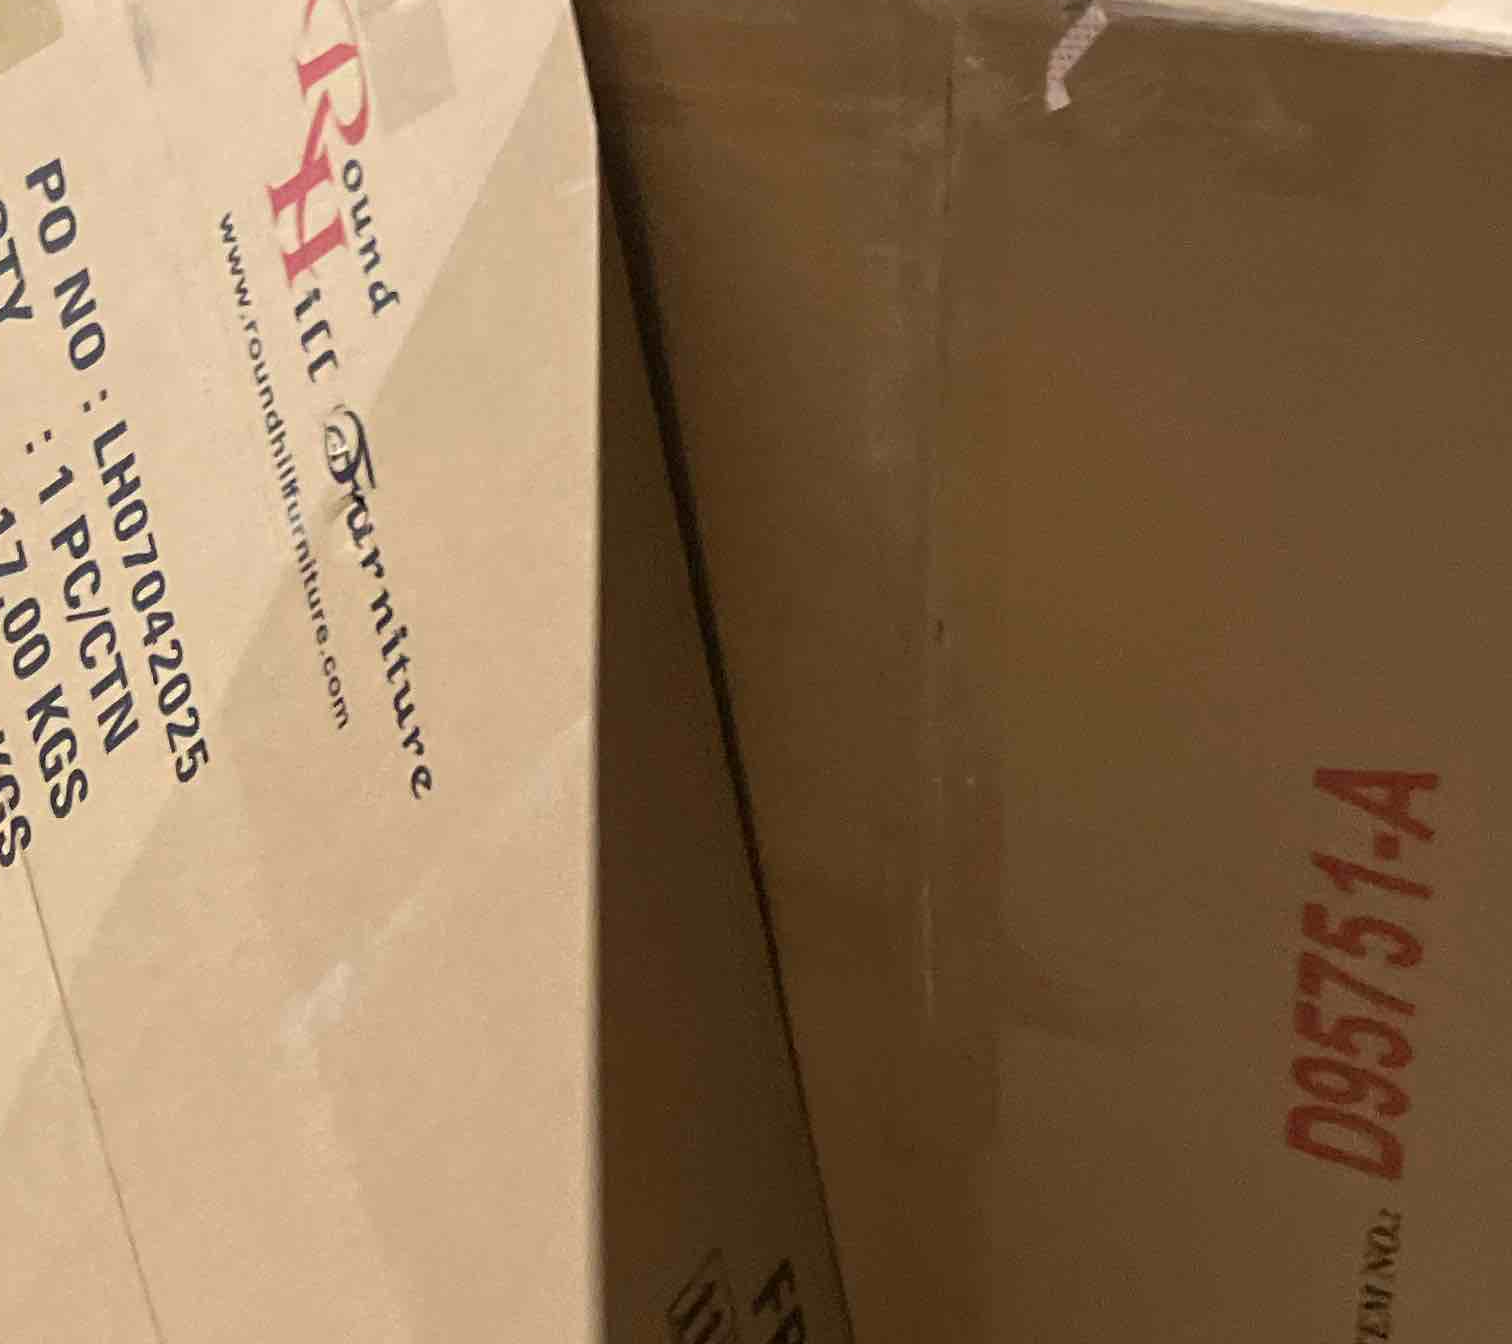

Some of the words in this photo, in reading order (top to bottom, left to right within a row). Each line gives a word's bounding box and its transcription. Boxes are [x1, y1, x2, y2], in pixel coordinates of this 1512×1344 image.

[25, 157, 77, 255] PO
[54, 267, 106, 371] NO
[93, 419, 209, 784] LH07042025
[38, 464, 75, 505] 1
[51, 513, 140, 755] PC/CTN
[219, 210, 351, 732] www.roundhillfurniture.com
[322, 402, 433, 801] Furniture
[26, 683, 88, 820] KGS
[1286, 768, 1440, 1182] D95751-A
